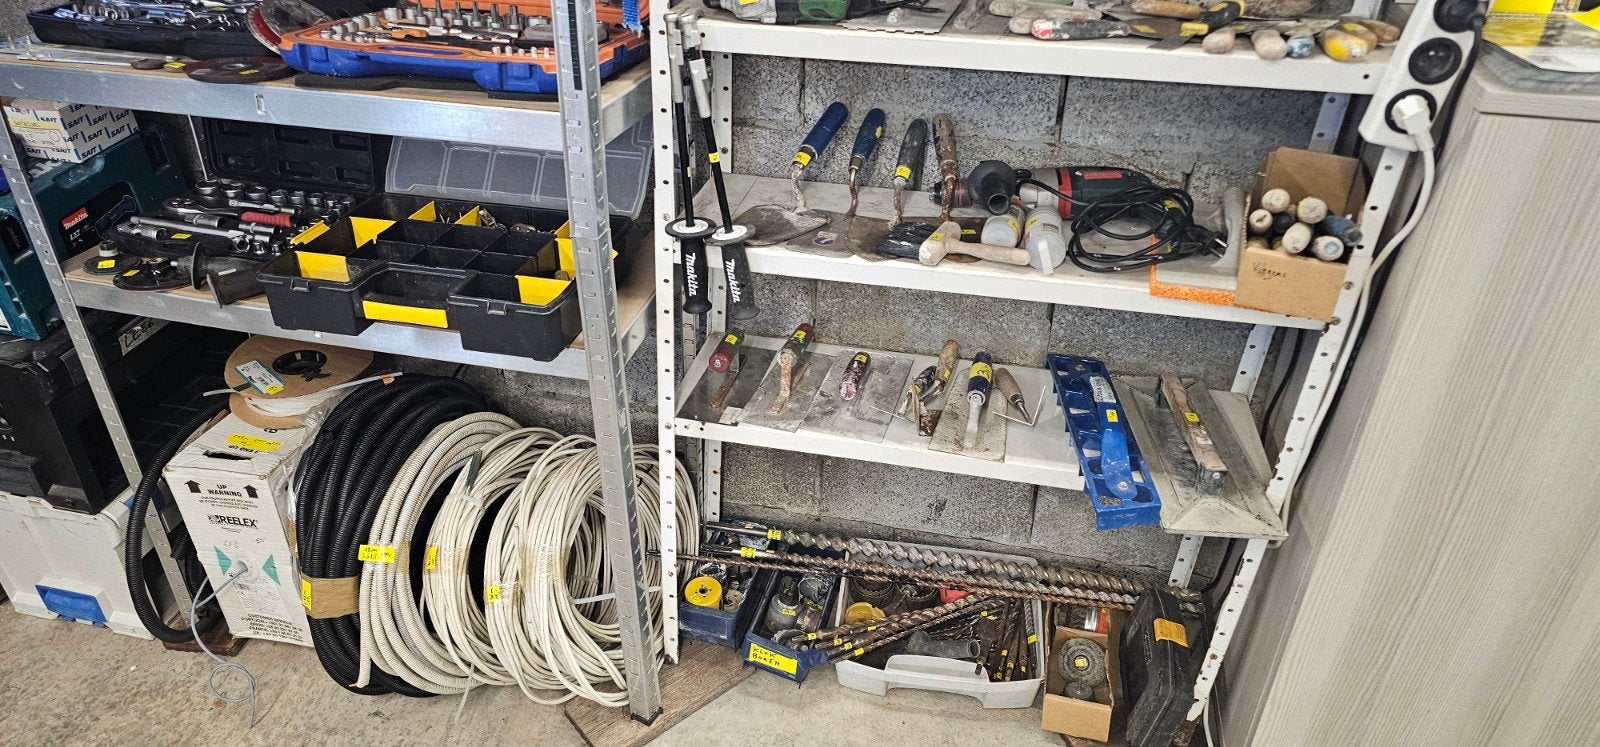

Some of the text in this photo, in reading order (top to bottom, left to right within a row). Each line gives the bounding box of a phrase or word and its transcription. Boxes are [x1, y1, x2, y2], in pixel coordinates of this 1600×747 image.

[92, 112, 108, 125] SAIT
[115, 109, 130, 121] SAIT
[68, 117, 83, 128] SAIT
[87, 129, 103, 142] SAIT
[110, 125, 126, 138] SAIT
[81, 147, 97, 159] SAIT
[207, 489, 243, 497] WARNING
[219, 515, 257, 528] REELEX
